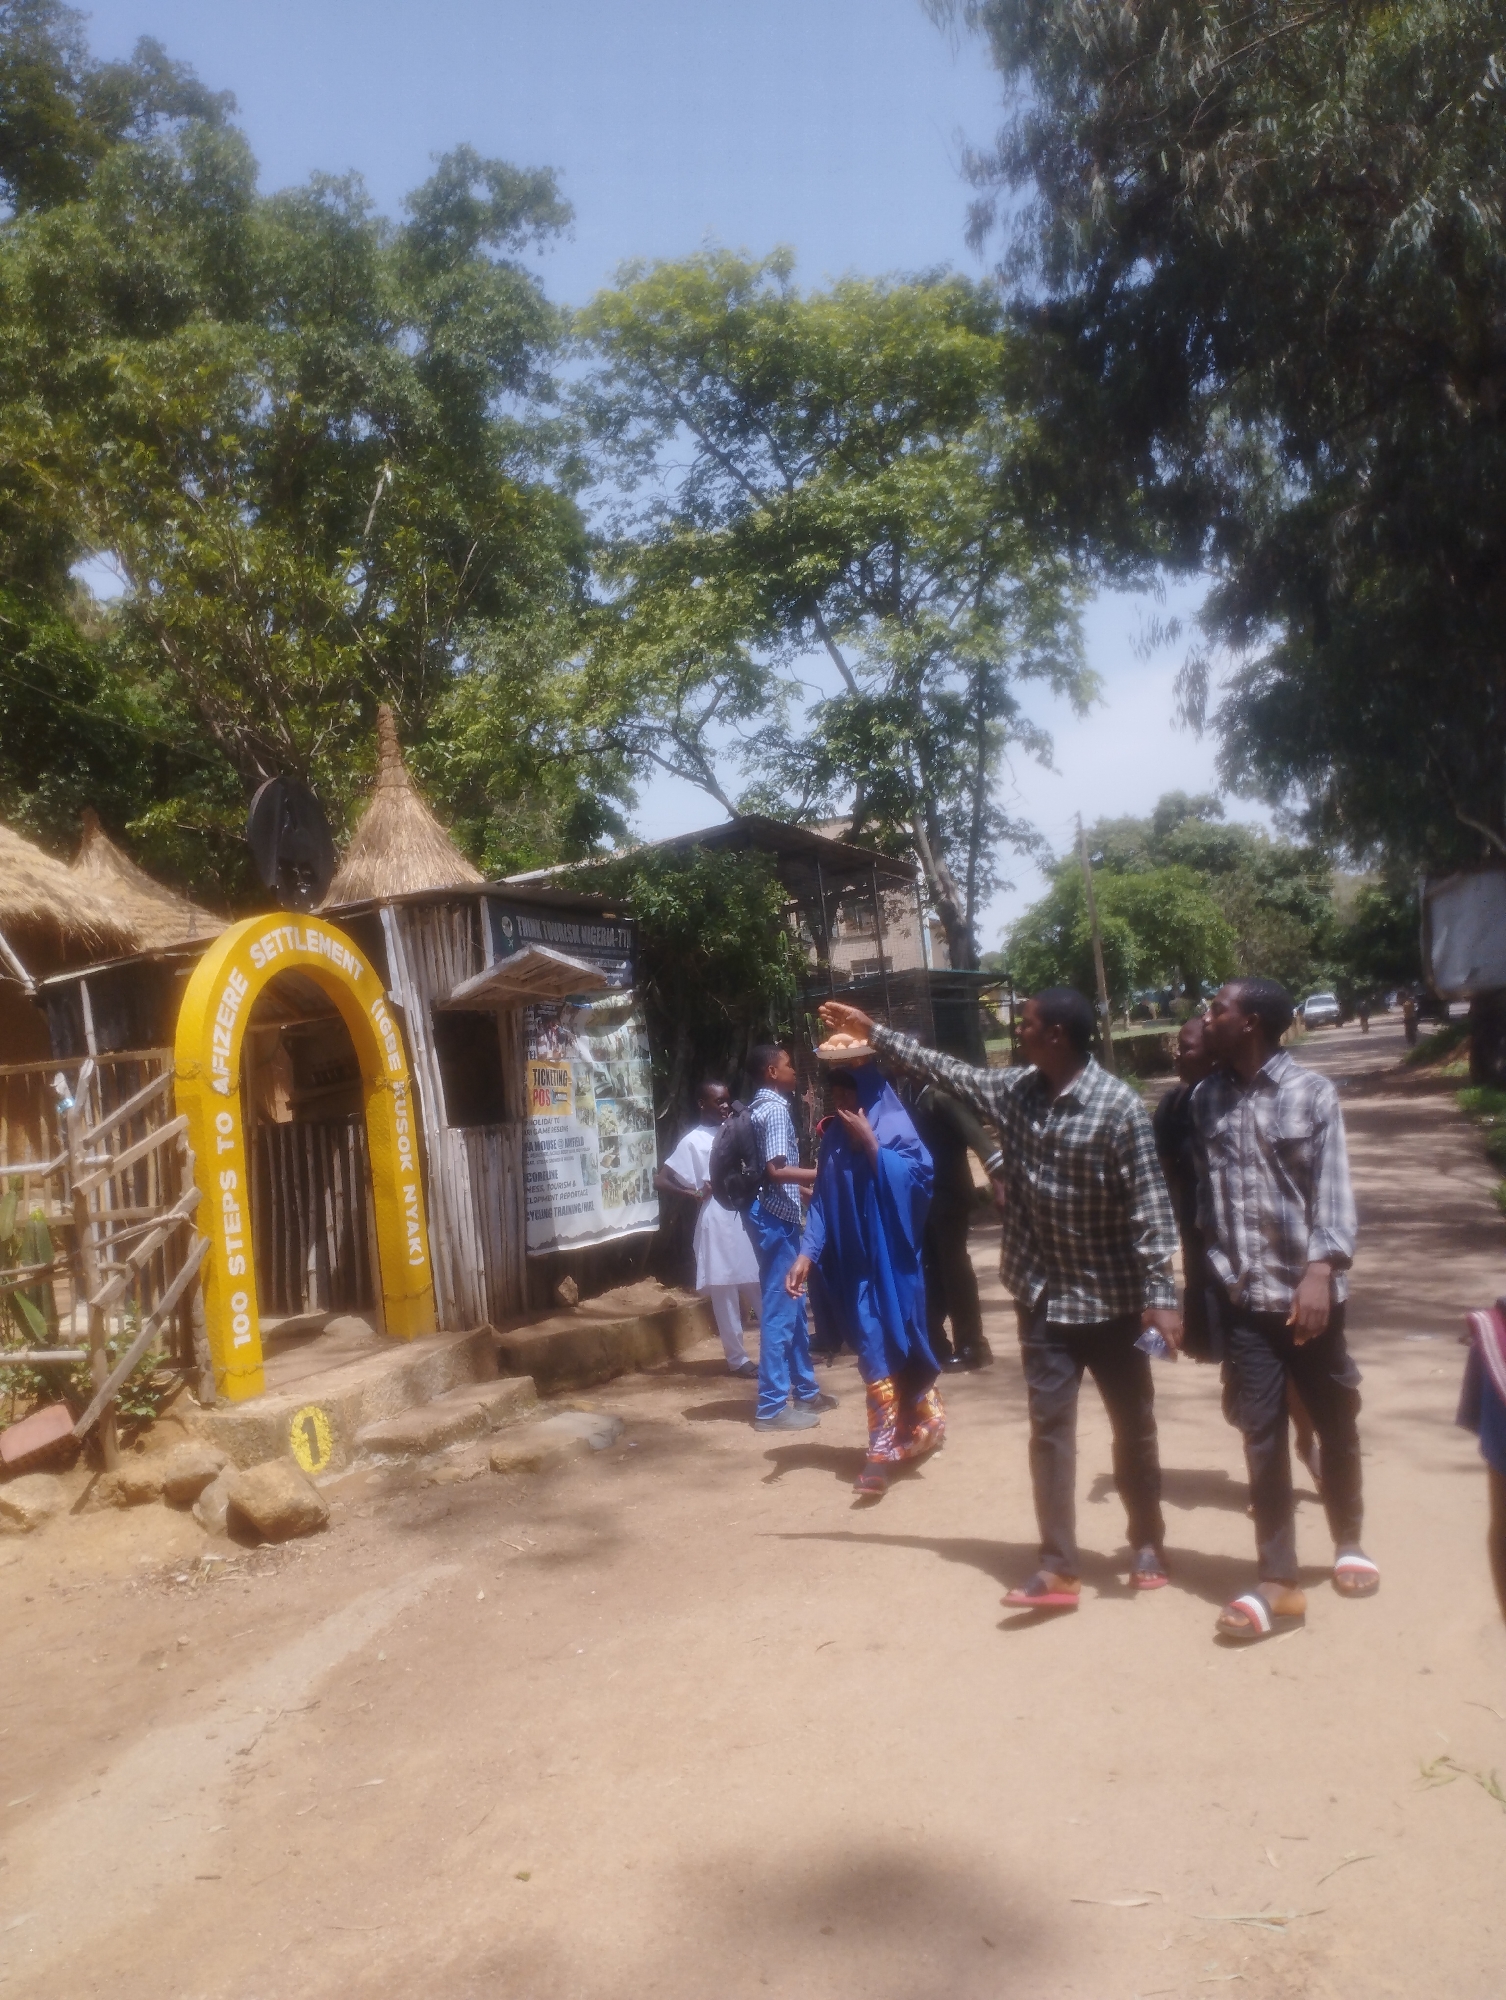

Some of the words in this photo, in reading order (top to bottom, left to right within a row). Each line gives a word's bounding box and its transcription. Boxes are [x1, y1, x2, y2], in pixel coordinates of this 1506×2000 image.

[249, 925, 364, 981] SETTLEMENT
[541, 920, 580, 944] TOURISM
[211, 966, 249, 1096] AFIZERE
[371, 998, 402, 1072] (IGBE
[532, 1068, 568, 1087] TICKETING
[533, 1088, 551, 1107] POS
[216, 1112, 235, 1155] TO
[393, 1081, 413, 1172] KUSOK
[217, 1171, 247, 1278] STEPS
[403, 1184, 424, 1267] NYAK)
[233, 1291, 252, 1349] 100
[303, 1416, 320, 1465] 1
